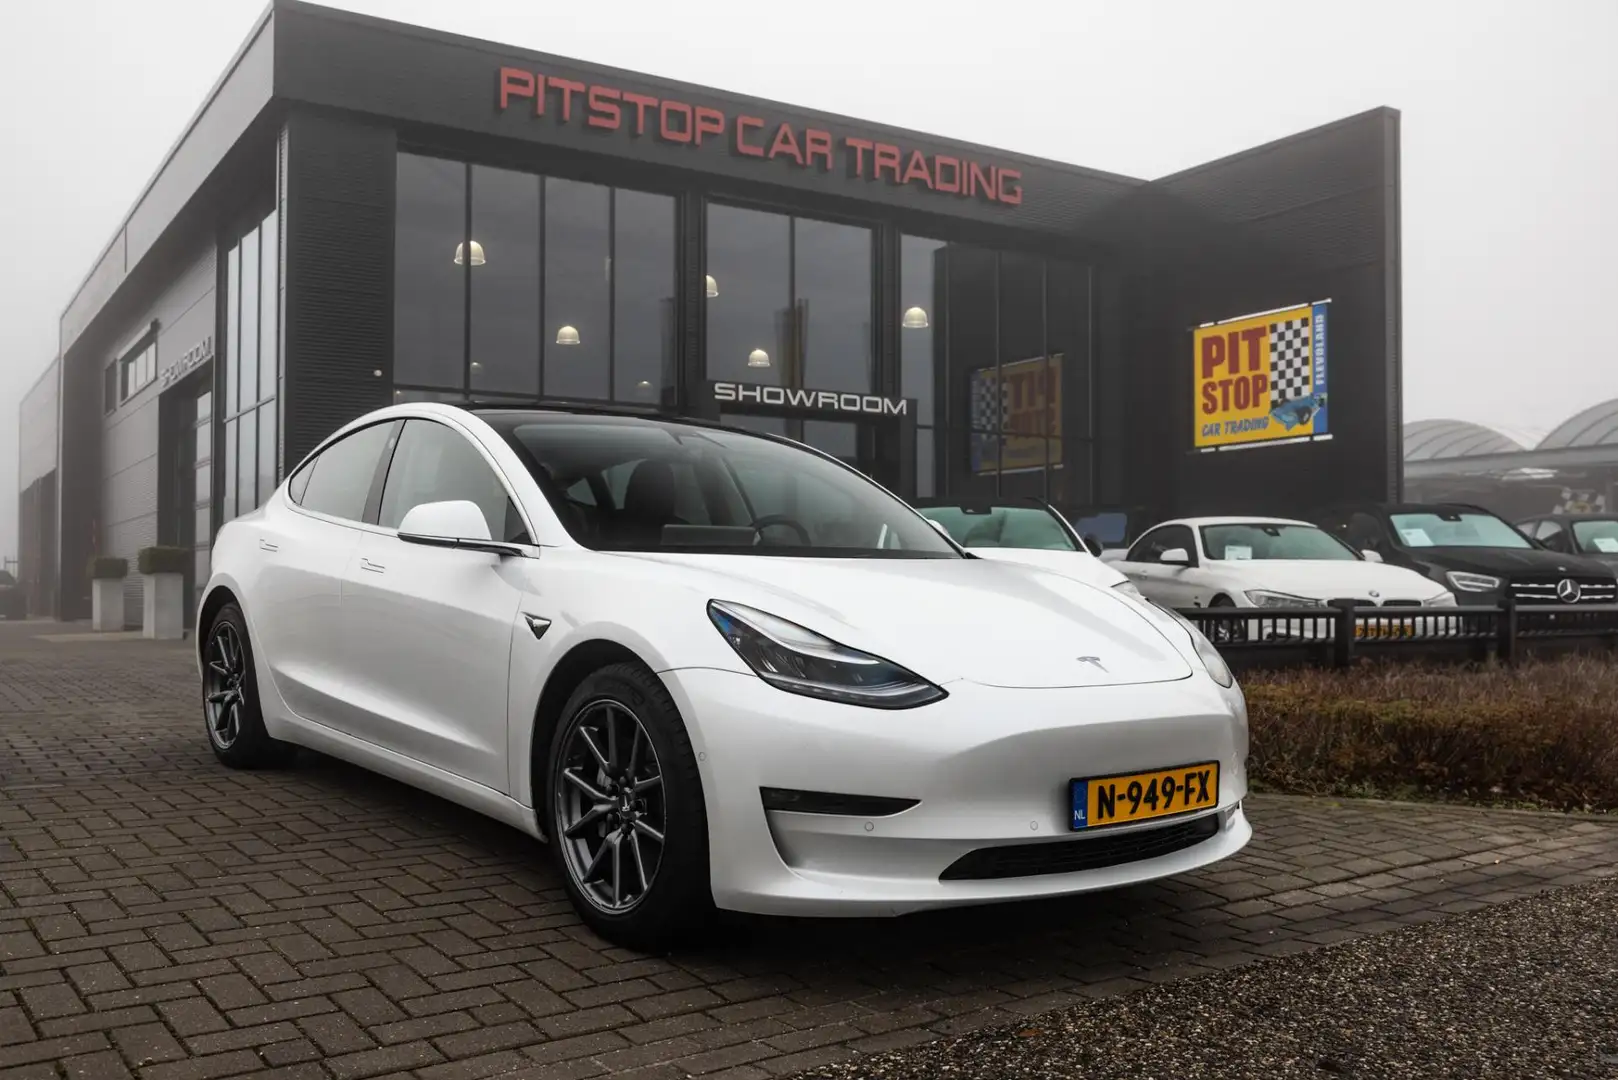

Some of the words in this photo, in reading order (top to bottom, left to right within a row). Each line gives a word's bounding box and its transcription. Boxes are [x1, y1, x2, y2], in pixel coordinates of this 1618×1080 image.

[499, 66, 725, 145] PITSTOP
[736, 115, 833, 170] CAR
[845, 137, 1023, 205] TRADING
[1202, 326, 1268, 379] PIT
[1315, 314, 1325, 385] FLEVOLAND
[714, 382, 907, 415] SHOWROOM
[1202, 374, 1268, 415] STOP
[1202, 421, 1221, 437] CAR
[1224, 416, 1269, 435] TRADING
[1074, 809, 1086, 820] NL
[1097, 769, 1211, 819] N-949-FX
